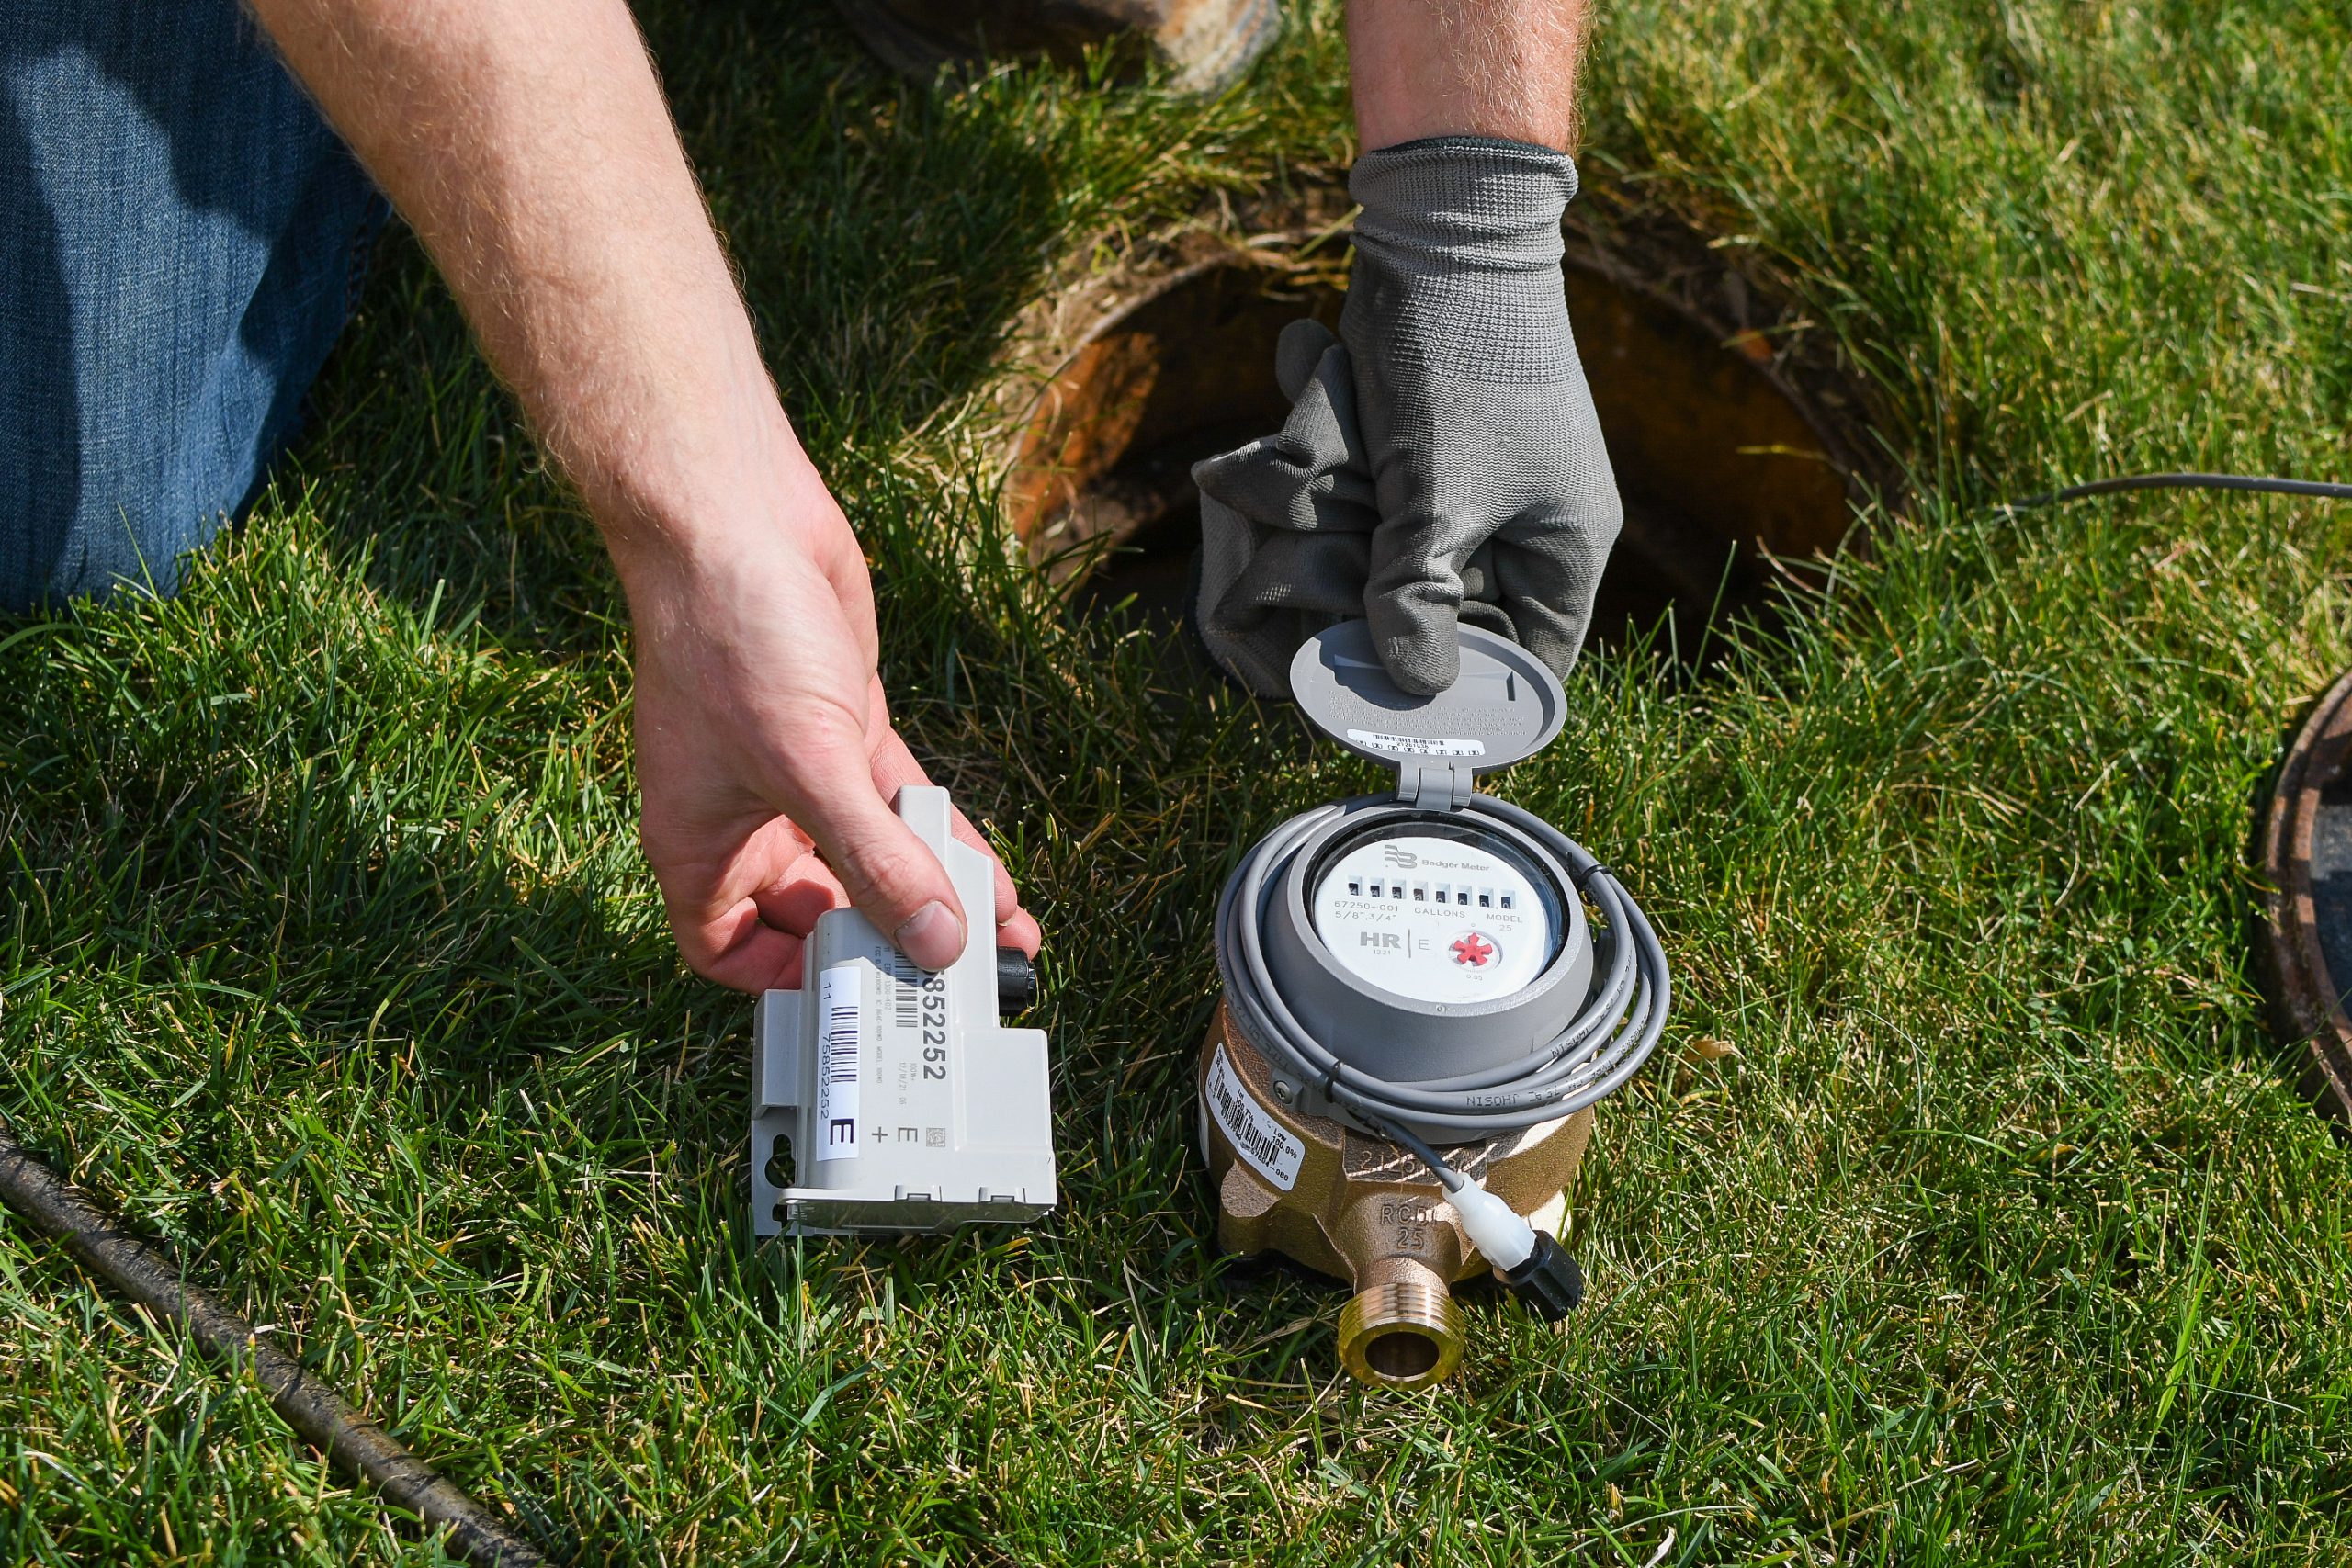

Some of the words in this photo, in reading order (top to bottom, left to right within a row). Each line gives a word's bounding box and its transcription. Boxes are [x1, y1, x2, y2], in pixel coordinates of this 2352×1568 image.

[1421, 859, 1458, 870] Badger
[1461, 863, 1490, 872] Meter
[1334, 900, 1399, 913] 67250-001
[1414, 907, 1466, 919] GALLONS
[1487, 913, 1523, 924] MODEL
[1360, 931, 1401, 950] HR
[1418, 939, 1430, 951] E
[823, 982, 831, 999] 11
[820, 1032, 831, 1120] 75852252
[830, 1118, 854, 1145] E
[898, 1127, 918, 1142] E
[1273, 1127, 1287, 1142] Low
[1272, 1135, 1298, 1159] 100.0%
[1396, 1228, 1424, 1249] 25
